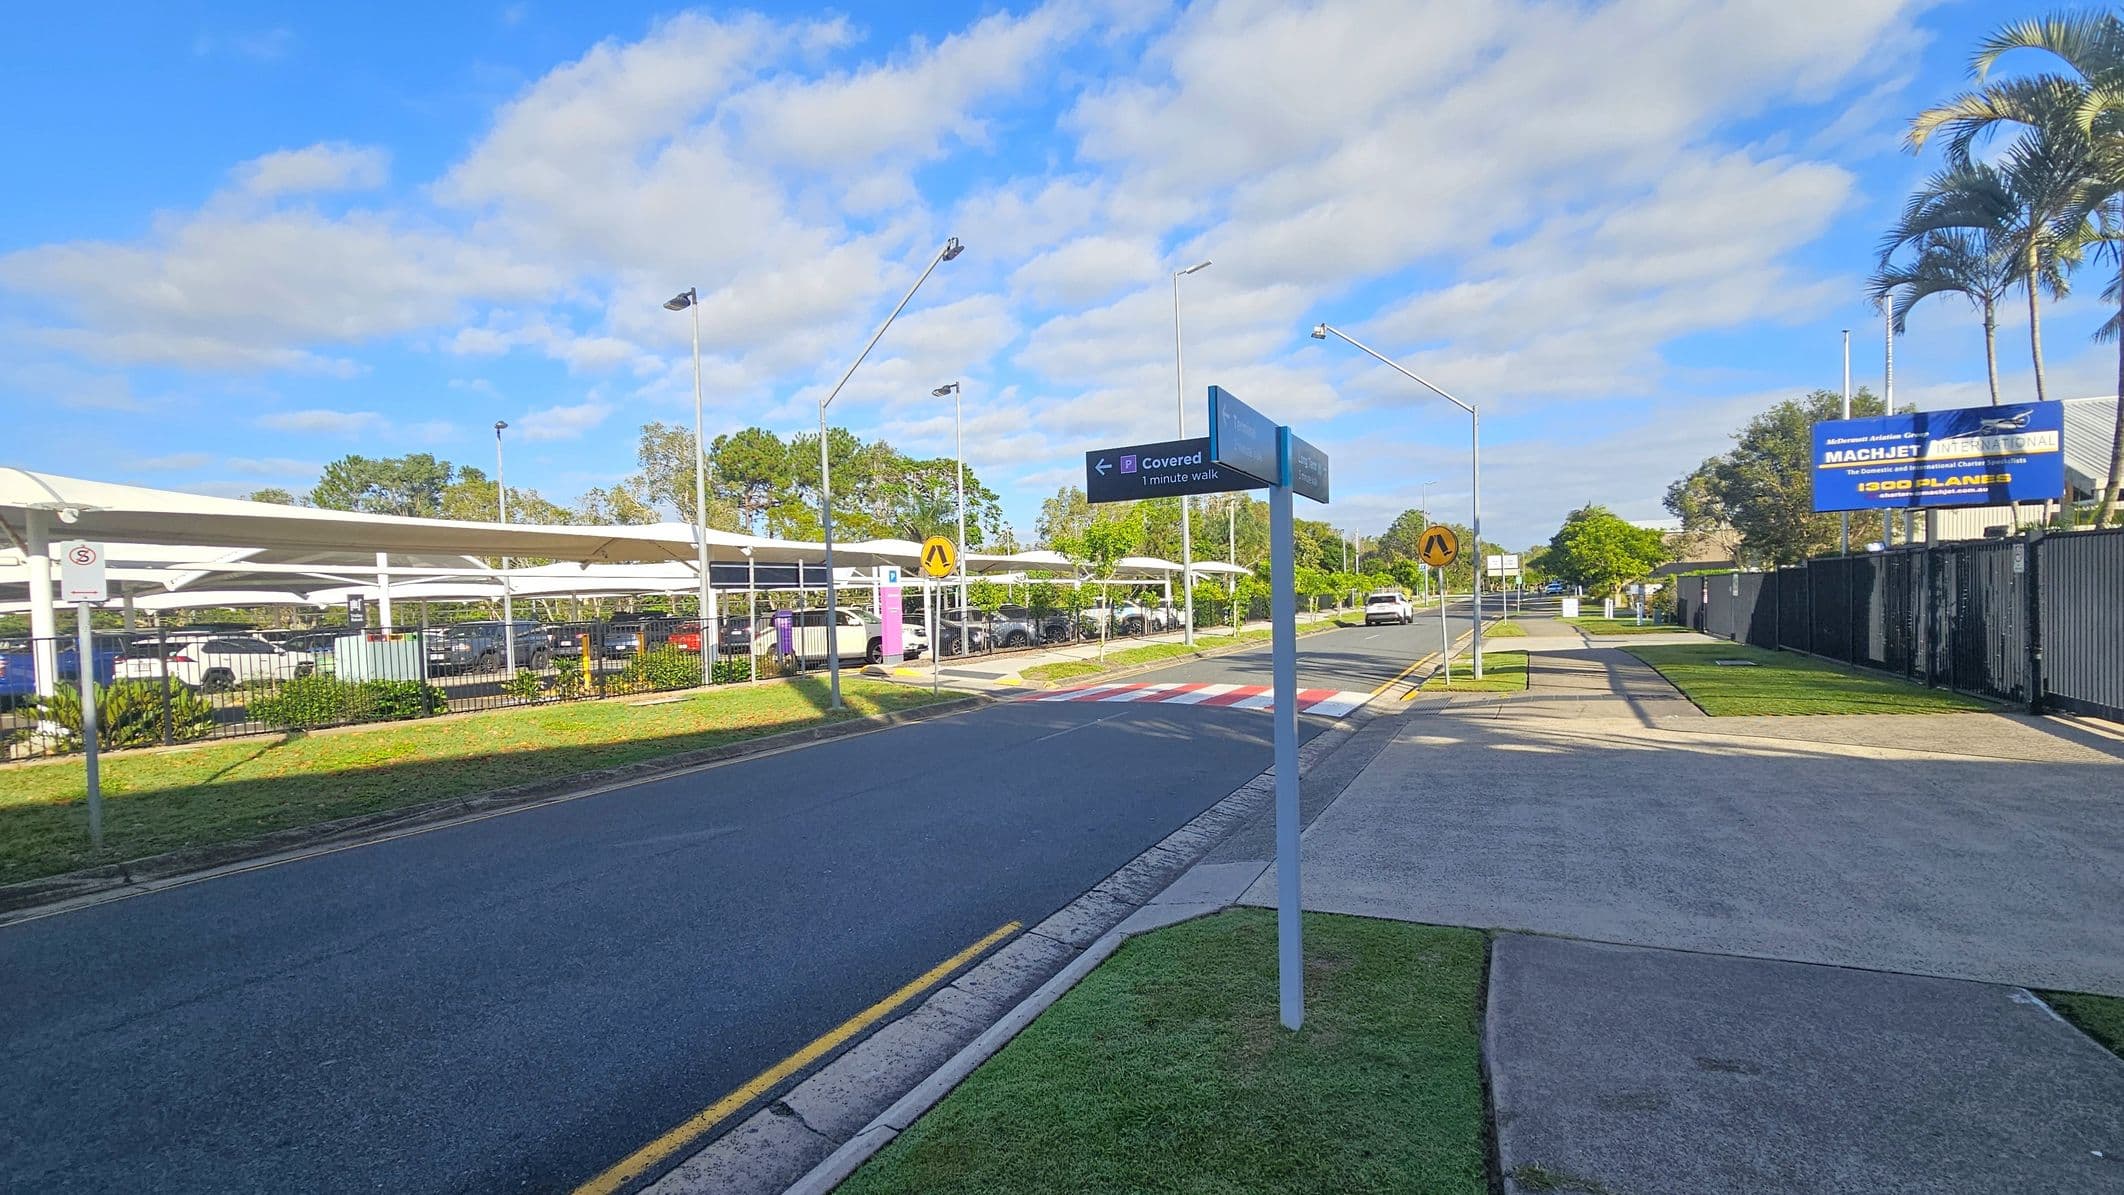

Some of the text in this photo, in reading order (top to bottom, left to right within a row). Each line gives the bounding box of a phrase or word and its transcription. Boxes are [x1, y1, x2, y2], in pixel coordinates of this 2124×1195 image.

[1826, 431, 1930, 445] McDermott Aviation Group
[1825, 436, 2055, 463] MACHJET INTERNATIONAL
[1142, 451, 1202, 469] Covered
[1860, 466, 1893, 475] Domestic
[1894, 465, 1908, 473] and
[1909, 461, 1956, 472] International
[1957, 459, 1985, 468] Charter
[1142, 468, 1219, 486] 1 minute walk
[1858, 473, 2012, 492] 1300 PLANES
